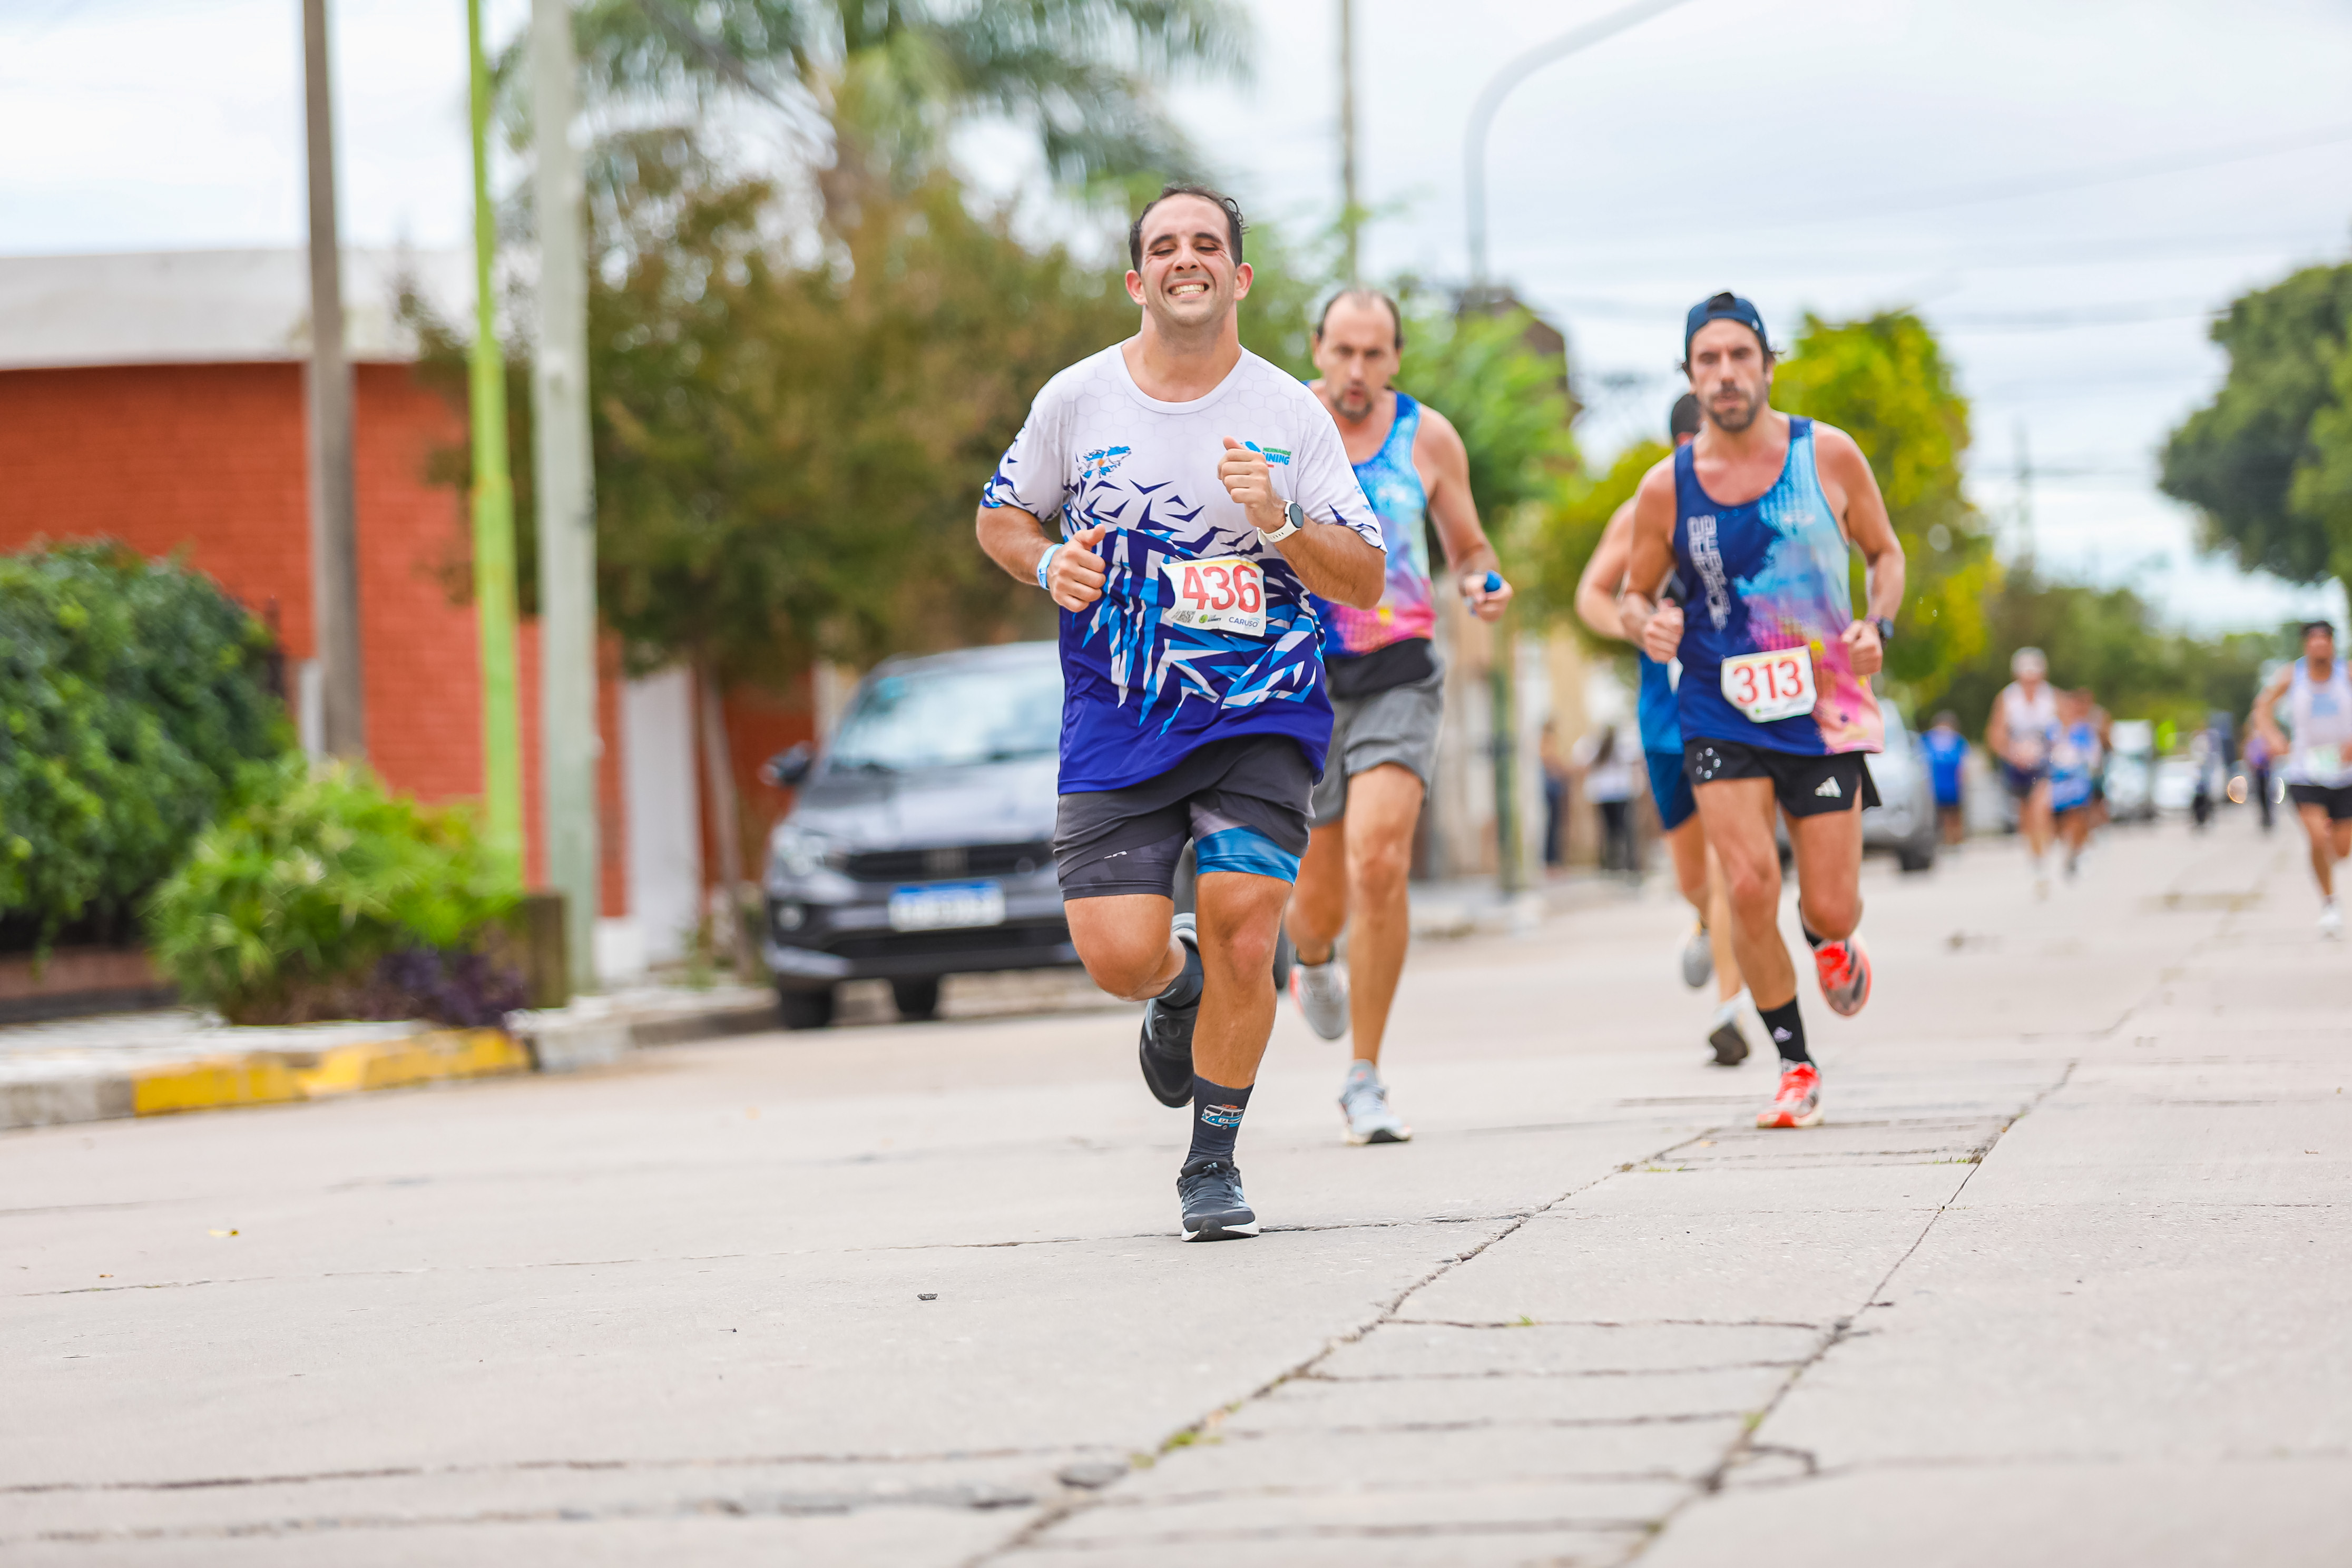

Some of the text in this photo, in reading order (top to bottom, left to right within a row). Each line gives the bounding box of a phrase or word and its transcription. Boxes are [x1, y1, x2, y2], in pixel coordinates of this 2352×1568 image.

[1183, 565, 1260, 613] 436
[1229, 616, 1258, 628] CARUSO
[1733, 661, 1804, 703] 313
